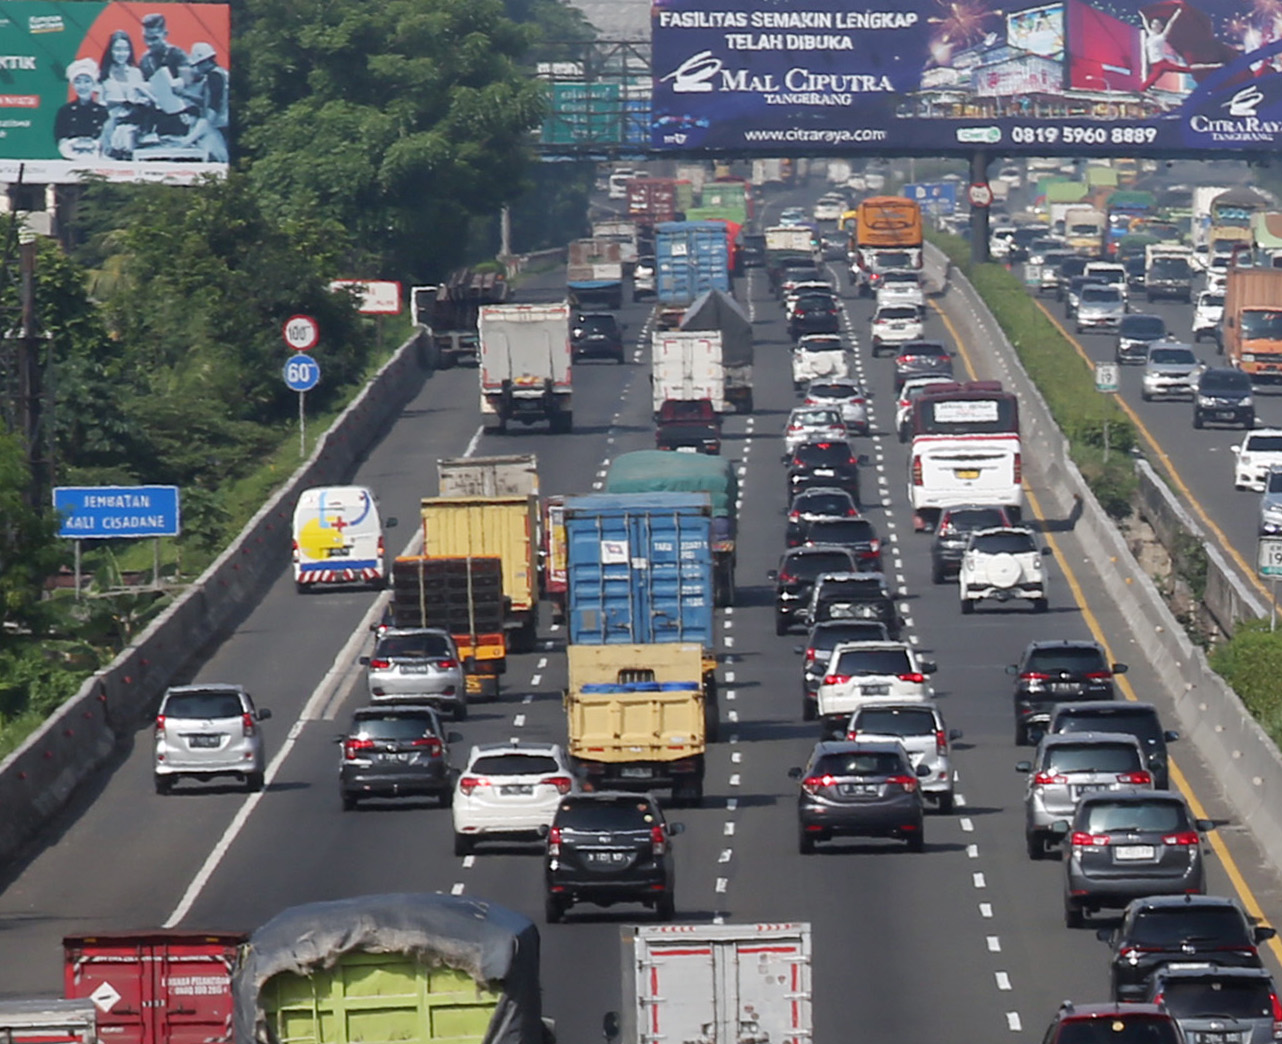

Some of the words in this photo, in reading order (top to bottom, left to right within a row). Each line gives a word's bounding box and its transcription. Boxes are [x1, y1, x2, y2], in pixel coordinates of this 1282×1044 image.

[660, 12, 747, 27] FASILITAS
[751, 12, 832, 28] SEMAKIN
[836, 12, 918, 28] LENGKAP
[725, 34, 783, 50] TELAH
[786, 34, 853, 50] DIBUKA
[719, 69, 779, 92] MAL
[785, 68, 895, 92] CIPUTRA
[764, 93, 852, 105] TANGERANG
[744, 128, 887, 144] www.citraraya.com
[1012, 126, 1058, 143] 0819
[1062, 127, 1106, 143] 5960
[1111, 127, 1157, 143] 8889
[287, 363, 310, 382] 60
[84, 495, 150, 508] JEMBATAN
[66, 517, 94, 529] KALI
[102, 515, 164, 529] CISADANE
[1269, 553, 1282, 564] 19
